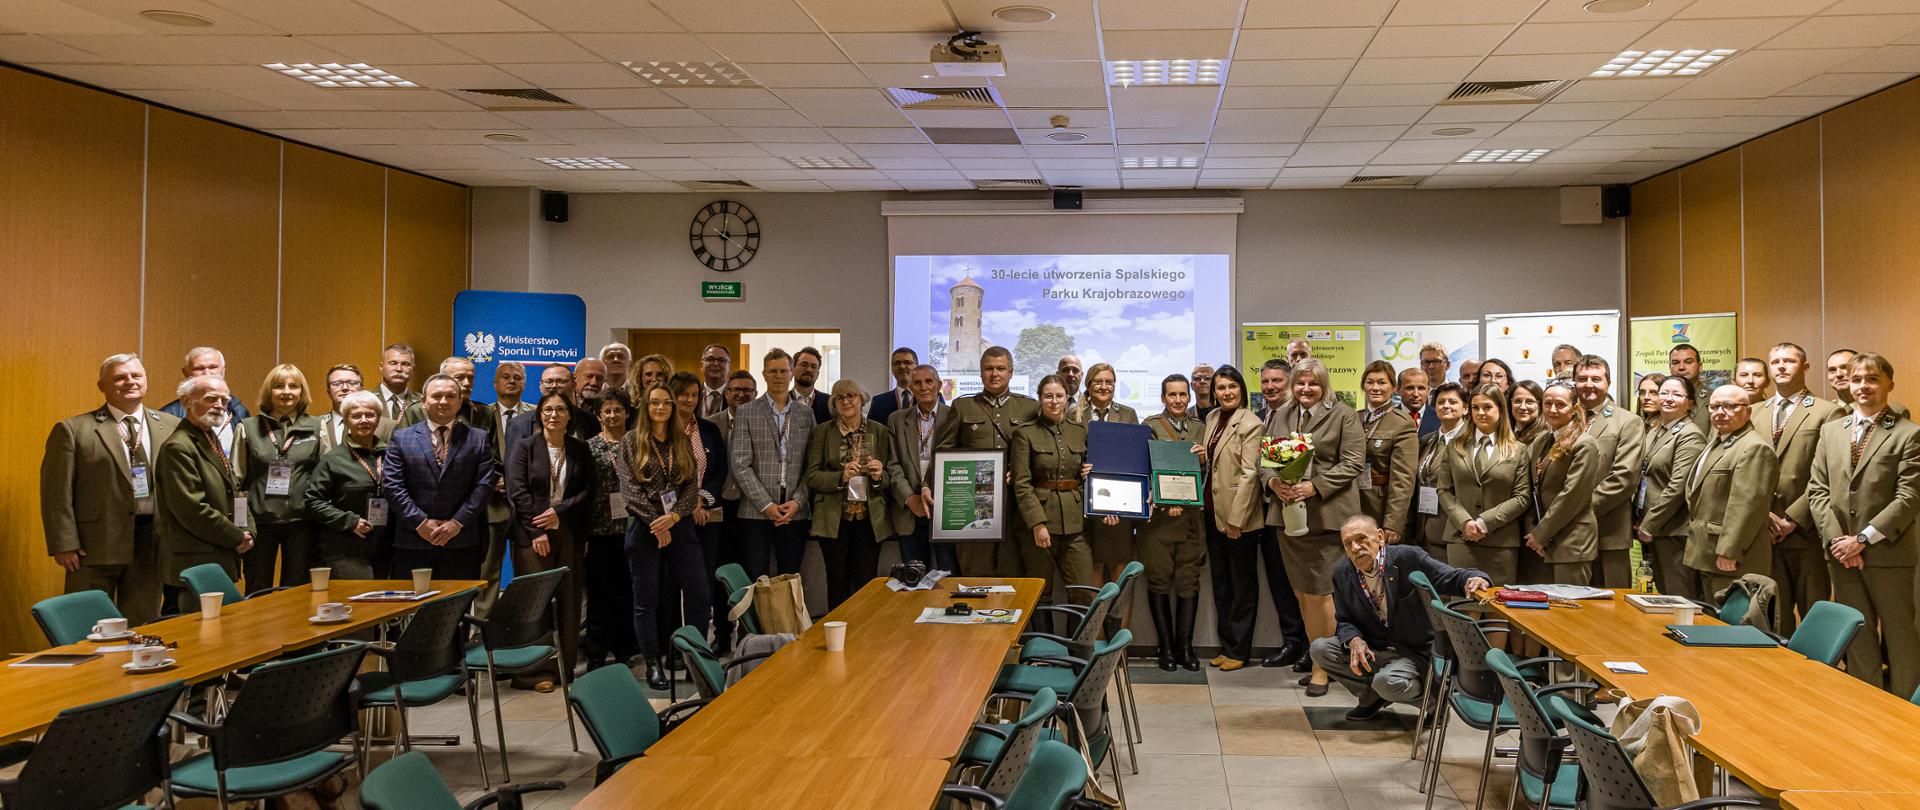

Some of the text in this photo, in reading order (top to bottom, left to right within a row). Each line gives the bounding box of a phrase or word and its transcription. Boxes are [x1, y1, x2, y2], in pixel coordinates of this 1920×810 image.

[991, 268, 1186, 282] 30-lecie utworzenia Spalskiego
[1042, 288, 1186, 301] Parku Krajobrazowego
[498, 335, 559, 346] Ministerstwo
[498, 346, 578, 359] Sportu i Turystyki
[1699, 348, 1732, 357] razowych
[1328, 367, 1358, 376] razowy
